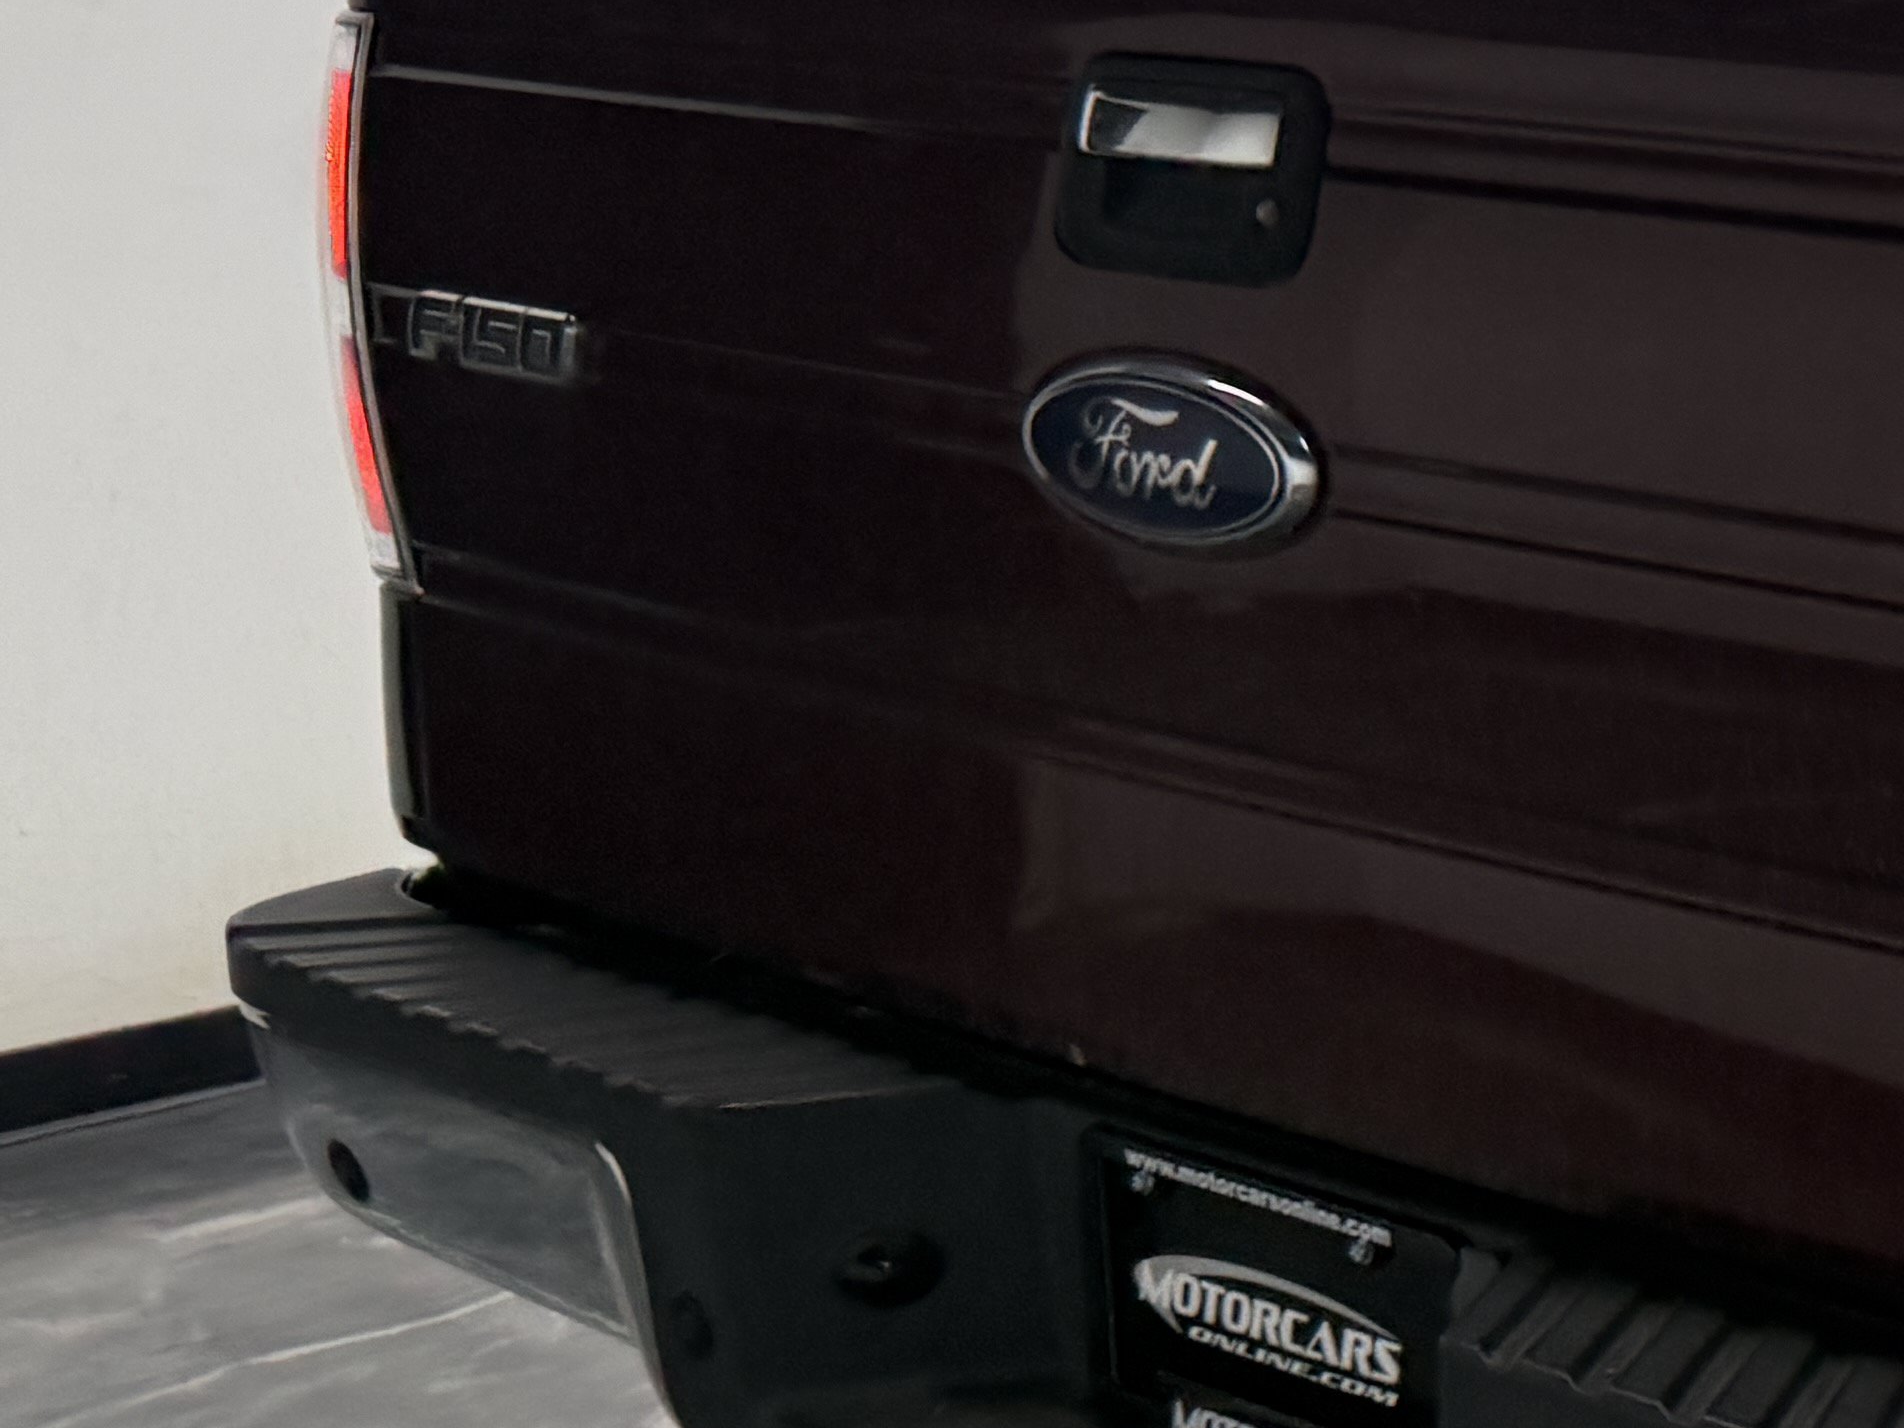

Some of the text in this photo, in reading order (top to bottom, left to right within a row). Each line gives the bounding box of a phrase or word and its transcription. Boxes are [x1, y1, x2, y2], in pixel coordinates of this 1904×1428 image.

[1069, 396, 1217, 509] Ford
[1138, 1260, 1402, 1386] MOTORCARS
[1187, 1325, 1399, 1408] ONLINE.COM
